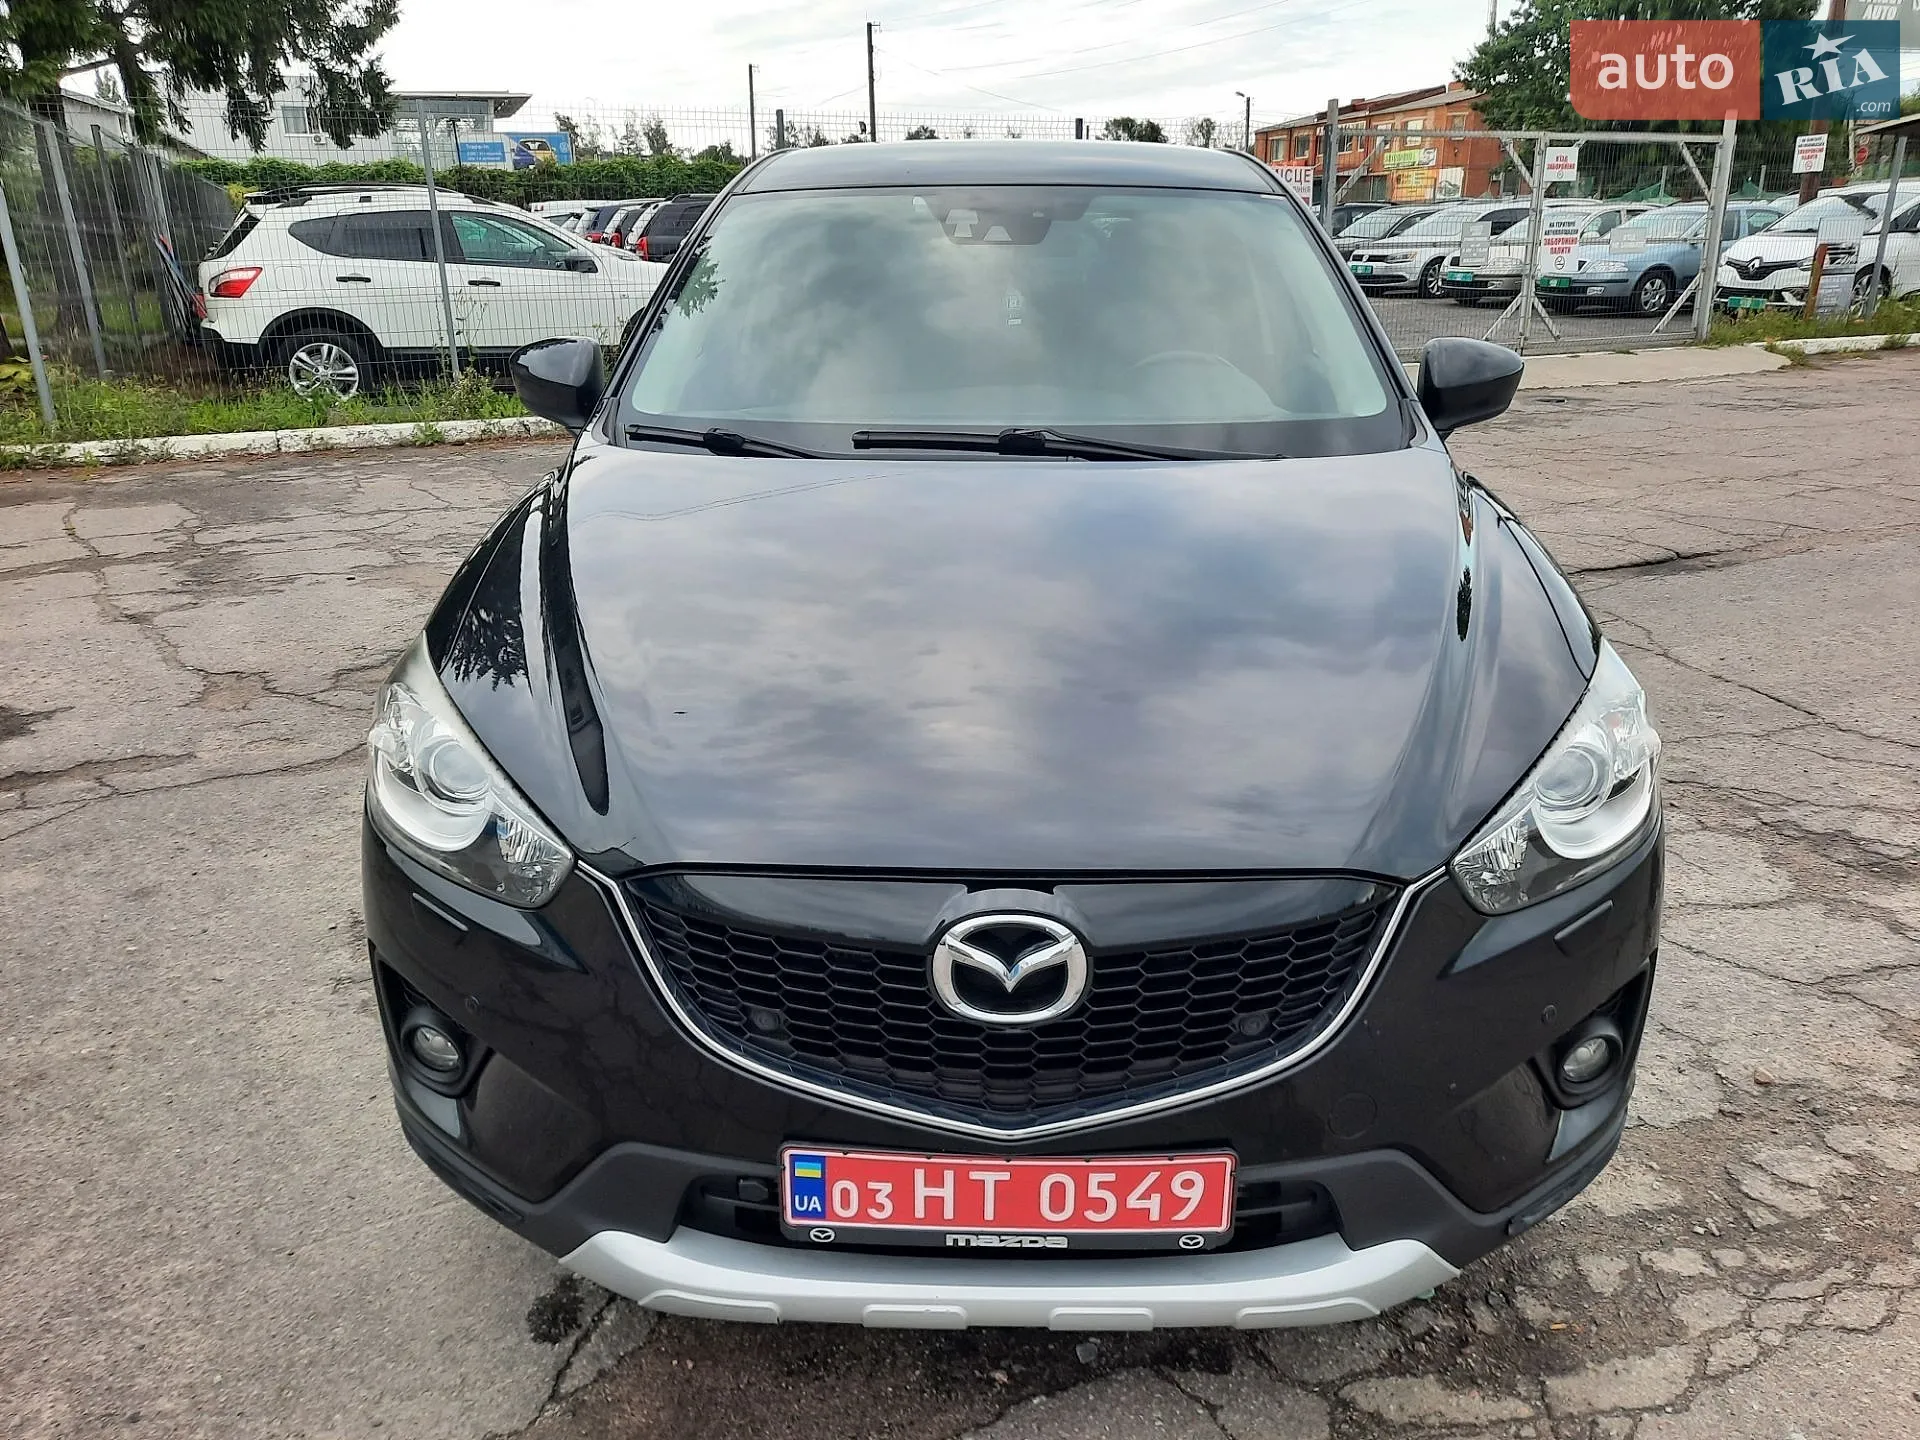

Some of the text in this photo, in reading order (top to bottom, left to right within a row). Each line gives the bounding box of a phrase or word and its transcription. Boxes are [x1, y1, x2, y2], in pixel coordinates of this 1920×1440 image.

[1862, 4, 1897, 20] AUTO
[1275, 169, 1311, 185] ІСЦЕ
[1544, 237, 1577, 245] ЗАБОРОНЕНО
[1550, 246, 1571, 254] ПАЛИТИ
[795, 1168, 1205, 1223] UA 03 HT 0549
[946, 1233, 1068, 1249] mazda
